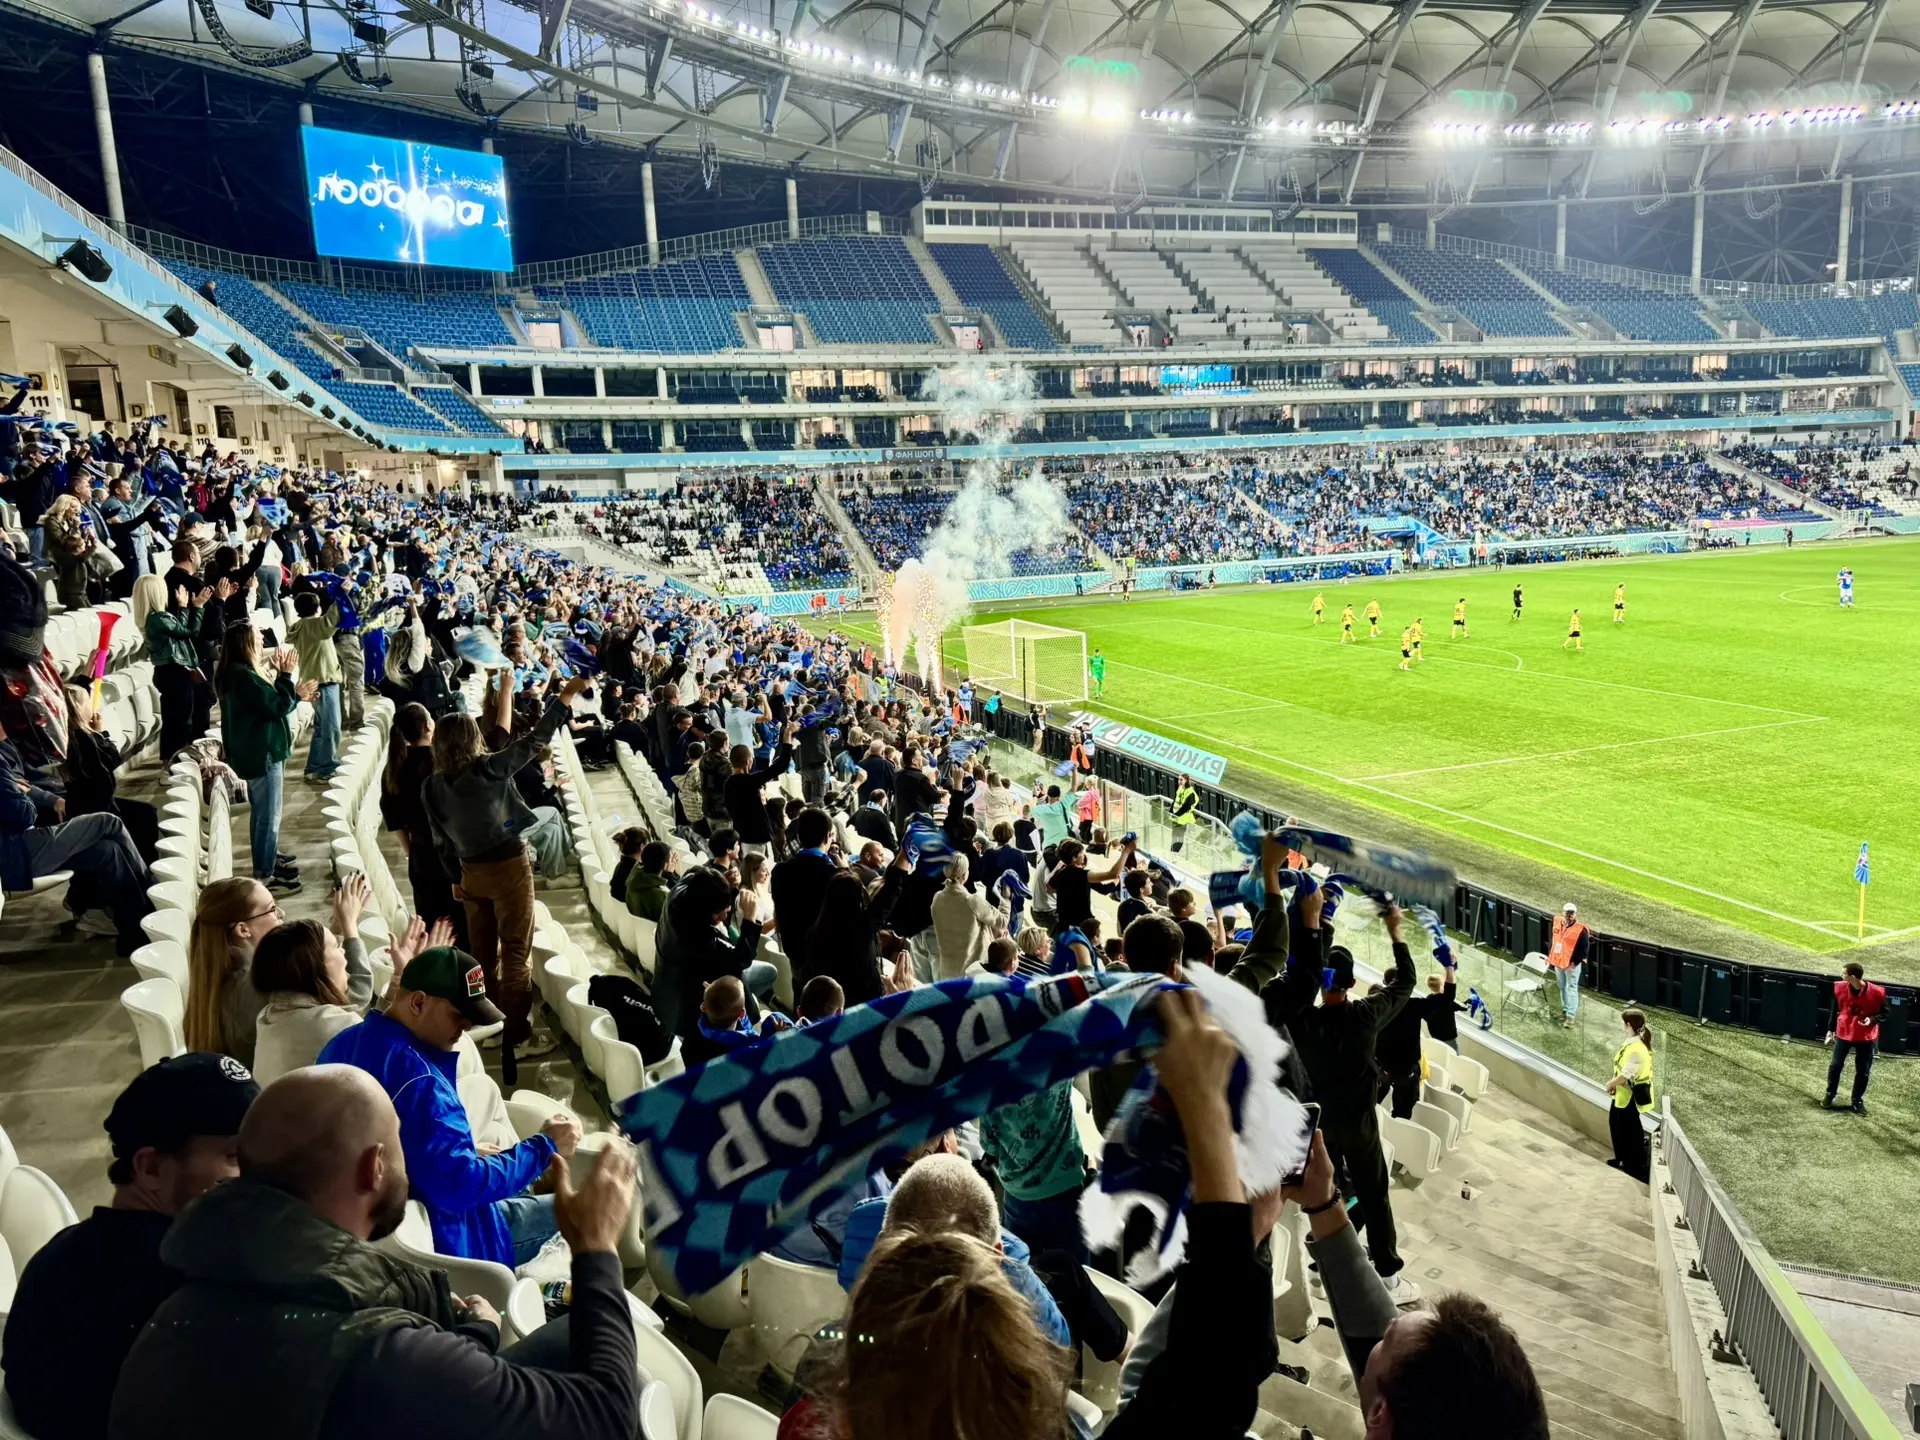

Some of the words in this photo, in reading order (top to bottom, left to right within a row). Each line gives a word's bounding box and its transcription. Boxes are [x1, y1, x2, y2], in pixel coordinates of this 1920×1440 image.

[29, 395, 50, 408] 111
[131, 404, 143, 418] D
[196, 424, 206, 435] D
[195, 437, 211, 446] 110
[241, 436, 250, 447] D
[239, 448, 255, 456] 109
[895, 451, 914, 459] ФАН
[914, 450, 934, 458] ШОП
[273, 456, 286, 464] 109
[1126, 733, 1224, 778] БУКМЕКЕР
